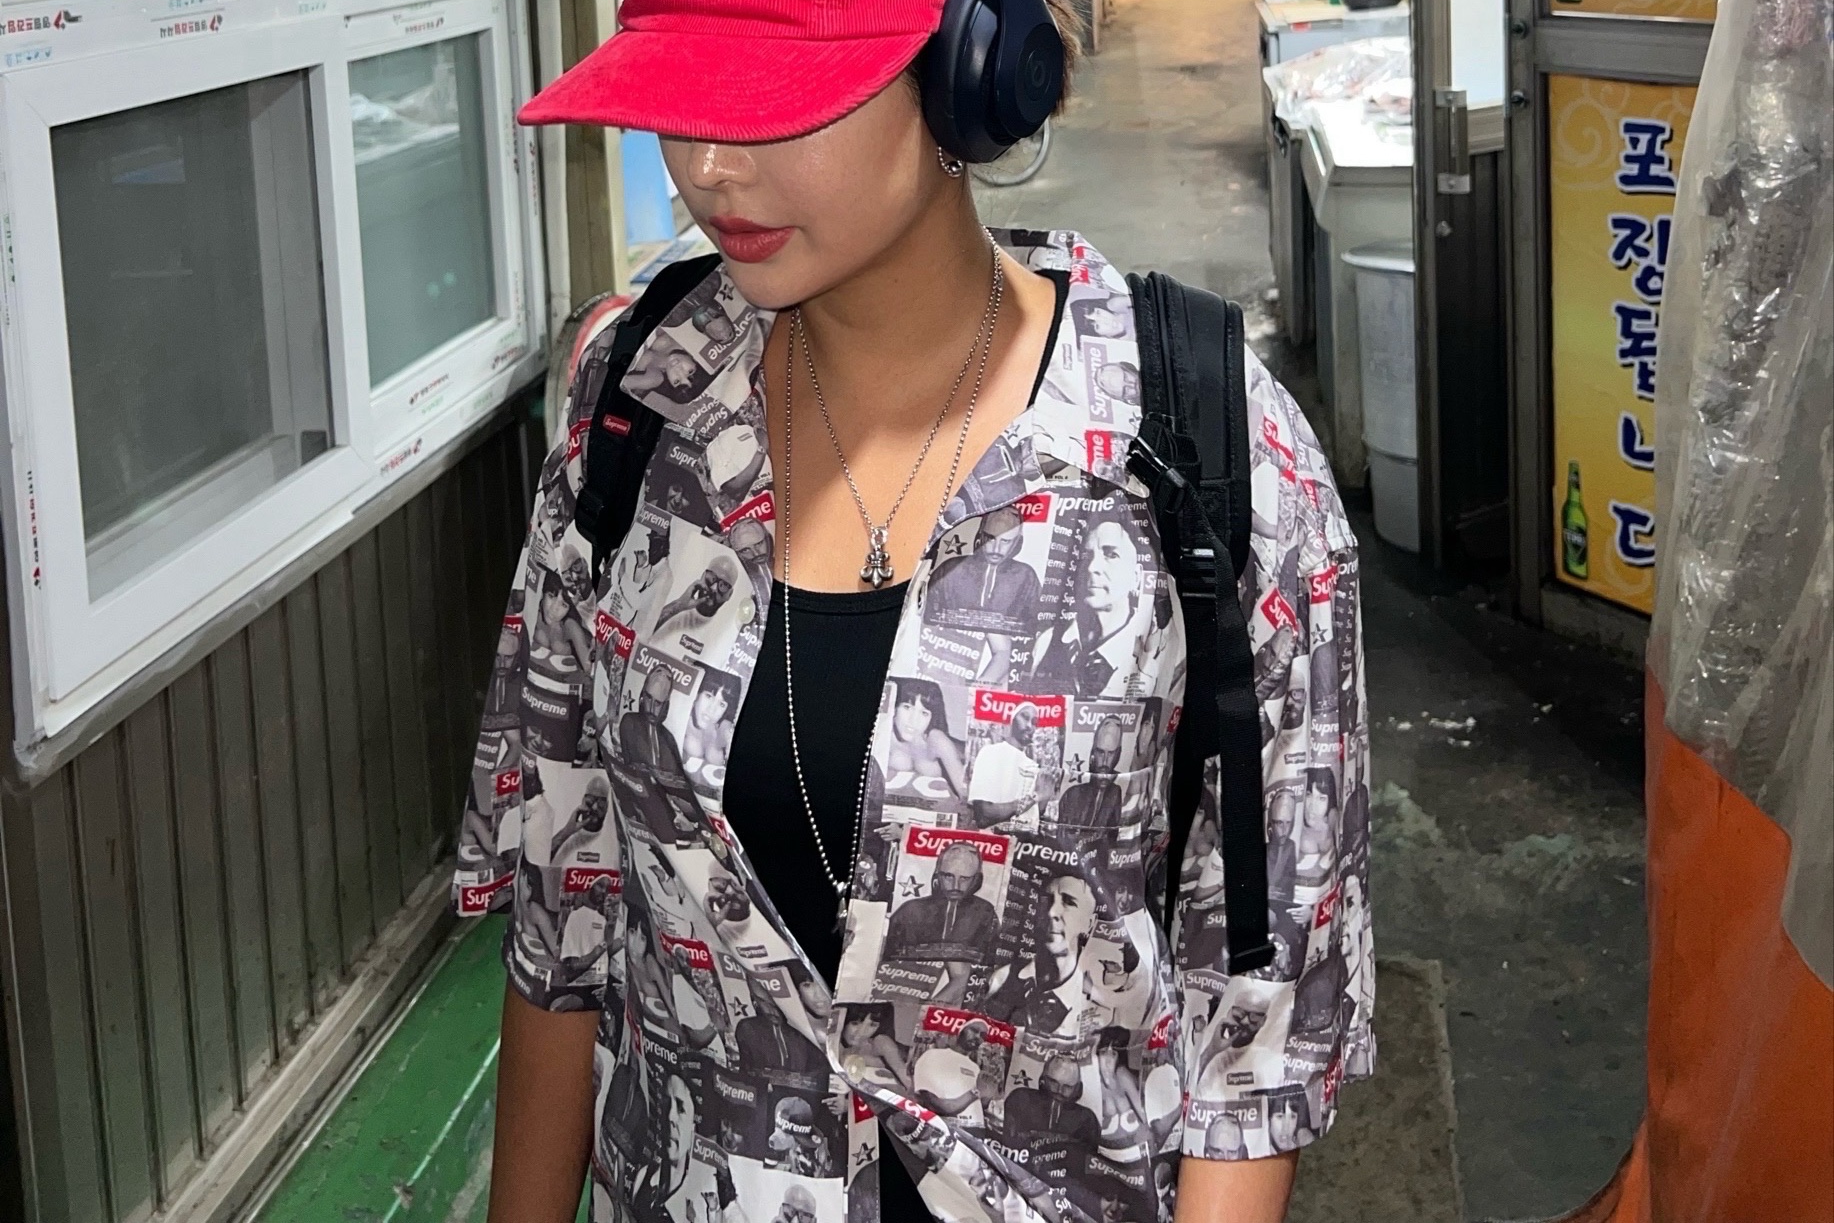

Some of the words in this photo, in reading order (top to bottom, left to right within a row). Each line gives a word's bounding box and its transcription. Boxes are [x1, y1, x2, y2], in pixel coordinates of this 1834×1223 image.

[0, 15, 52, 35] 영림프라임샤
[707, 311, 756, 360] Supme
[920, 627, 980, 661] Supreme
[636, 646, 693, 688] Supme
[916, 646, 976, 681] Supreme
[521, 686, 568, 716] Supreme
[979, 693, 1062, 719] Supme
[1077, 705, 1136, 730] Supme
[914, 831, 1004, 857] Supme
[878, 963, 938, 984] Supreme
[872, 978, 931, 1001] Supreme
[716, 1074, 755, 1103] Supreme
[1190, 1100, 1258, 1124] Supme
[1088, 1156, 1145, 1187] Supreme
